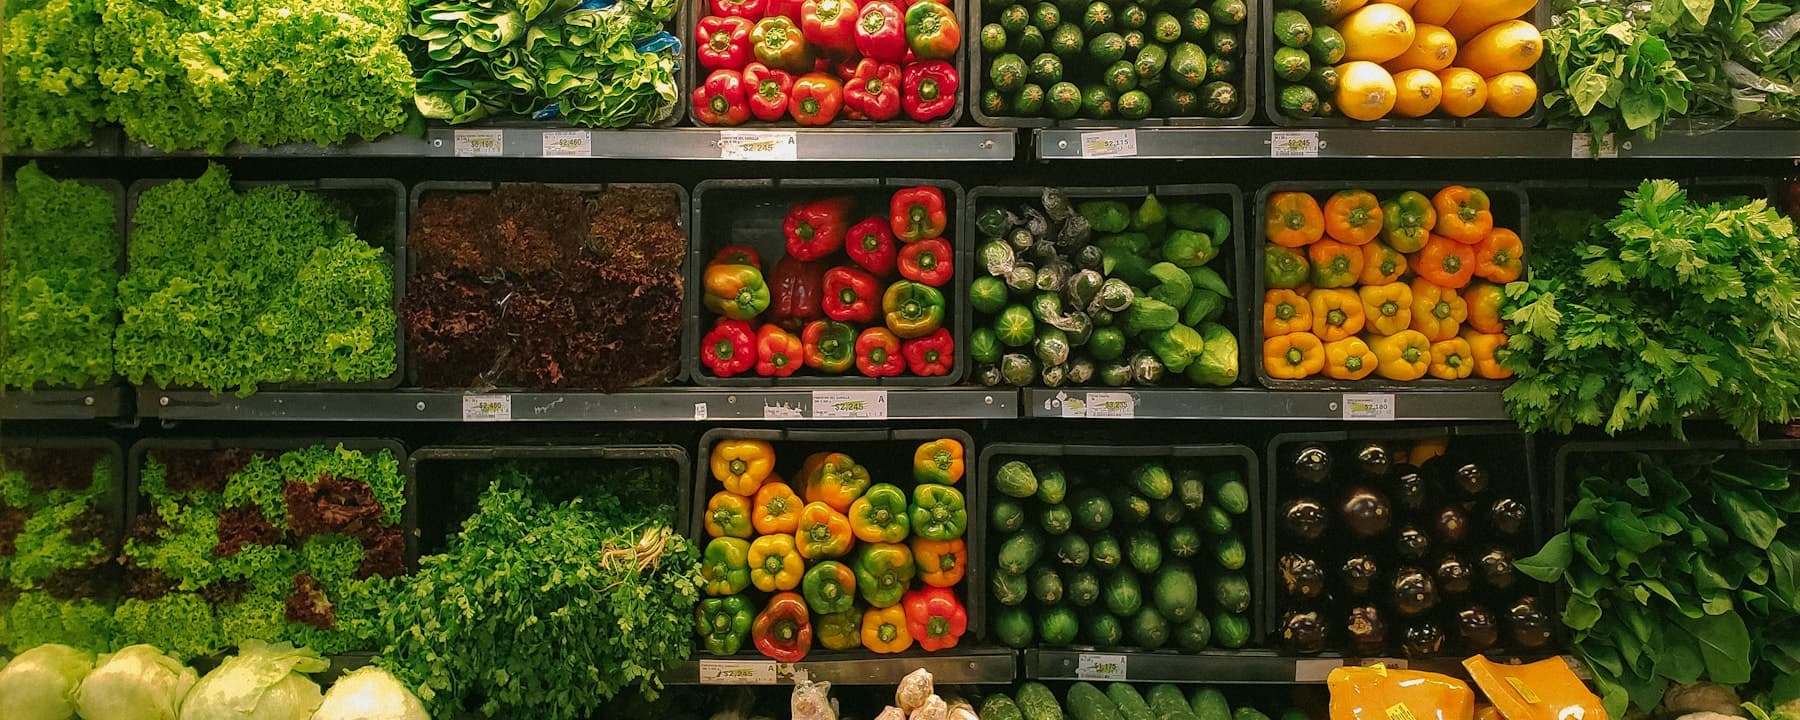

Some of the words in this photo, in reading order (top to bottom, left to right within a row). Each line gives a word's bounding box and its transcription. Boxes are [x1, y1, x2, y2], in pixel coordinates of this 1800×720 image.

[787, 136, 796, 144] A
[878, 395, 885, 403] A
[834, 402, 865, 412] $2,245
